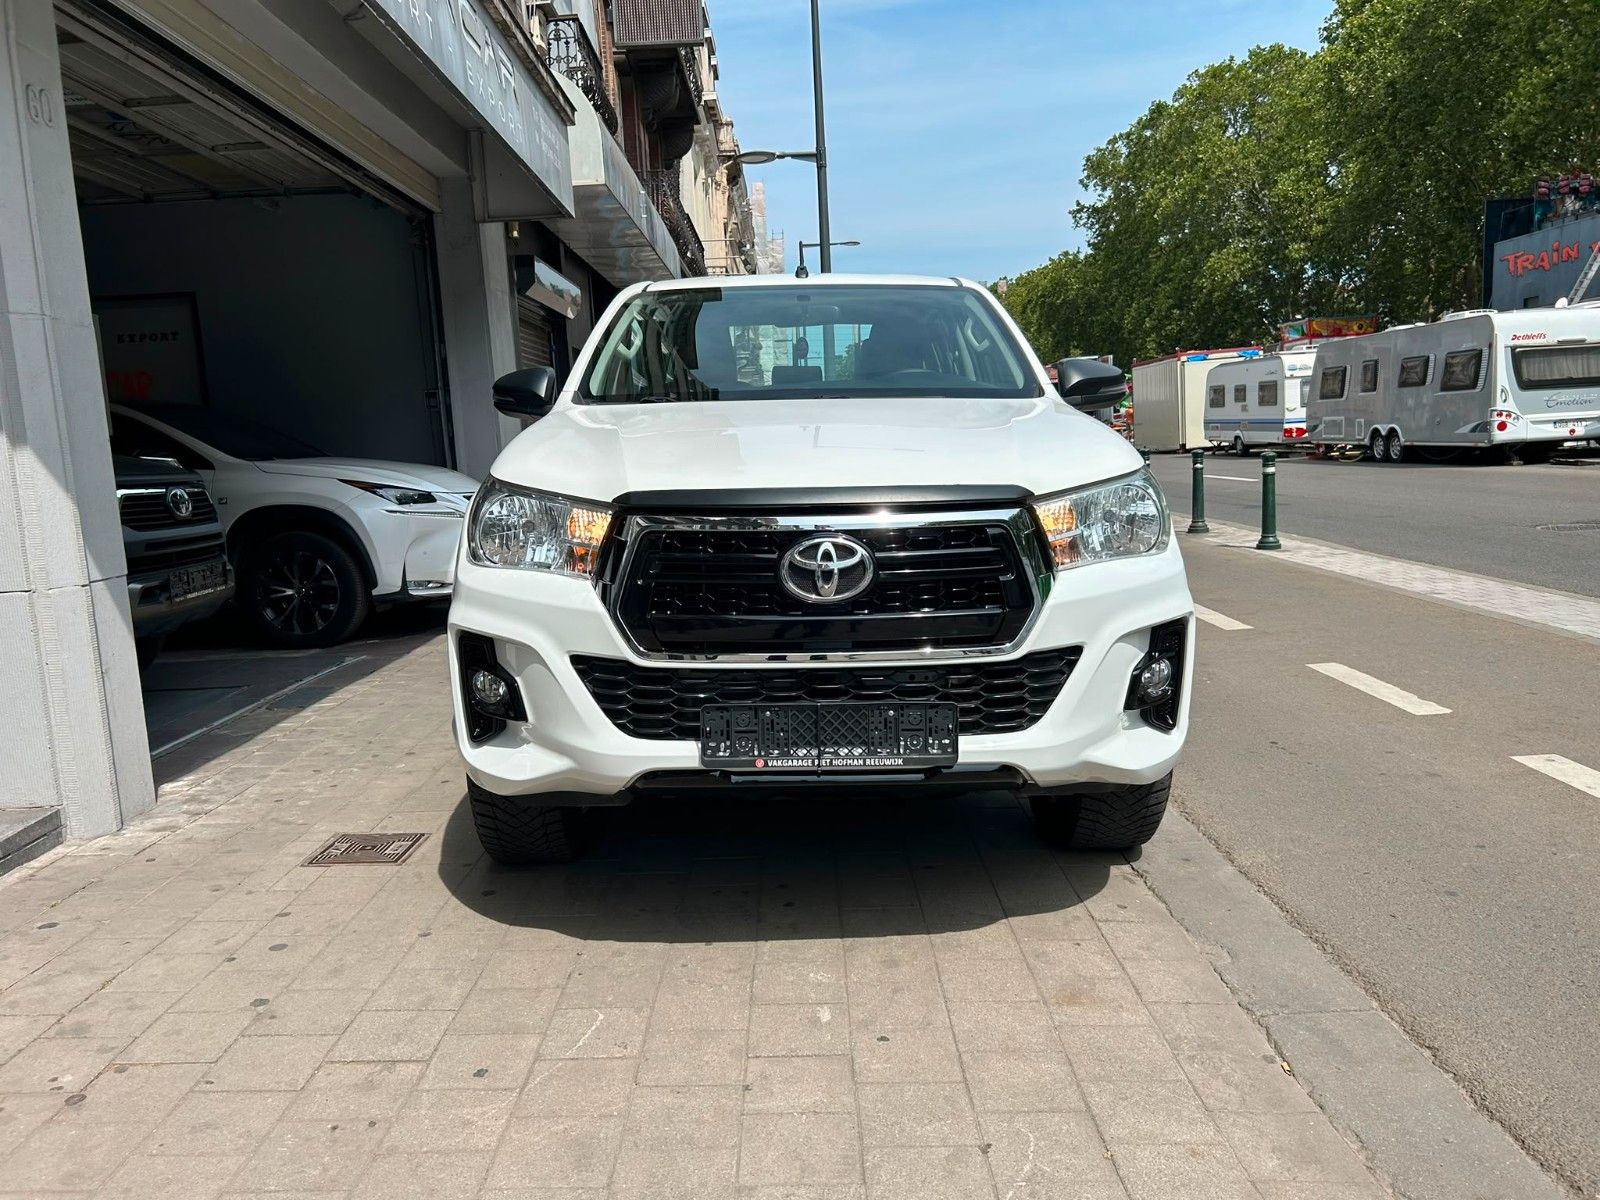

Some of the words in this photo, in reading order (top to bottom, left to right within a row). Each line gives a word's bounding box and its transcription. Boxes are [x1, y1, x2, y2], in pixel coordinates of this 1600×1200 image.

[466, 60, 523, 143] EXPORT
[117, 330, 179, 345] EXPORT
[767, 758, 813, 768] VAKGARAGE
[832, 758, 864, 767] HOFMAN
[865, 757, 904, 767] REEUWIJK
